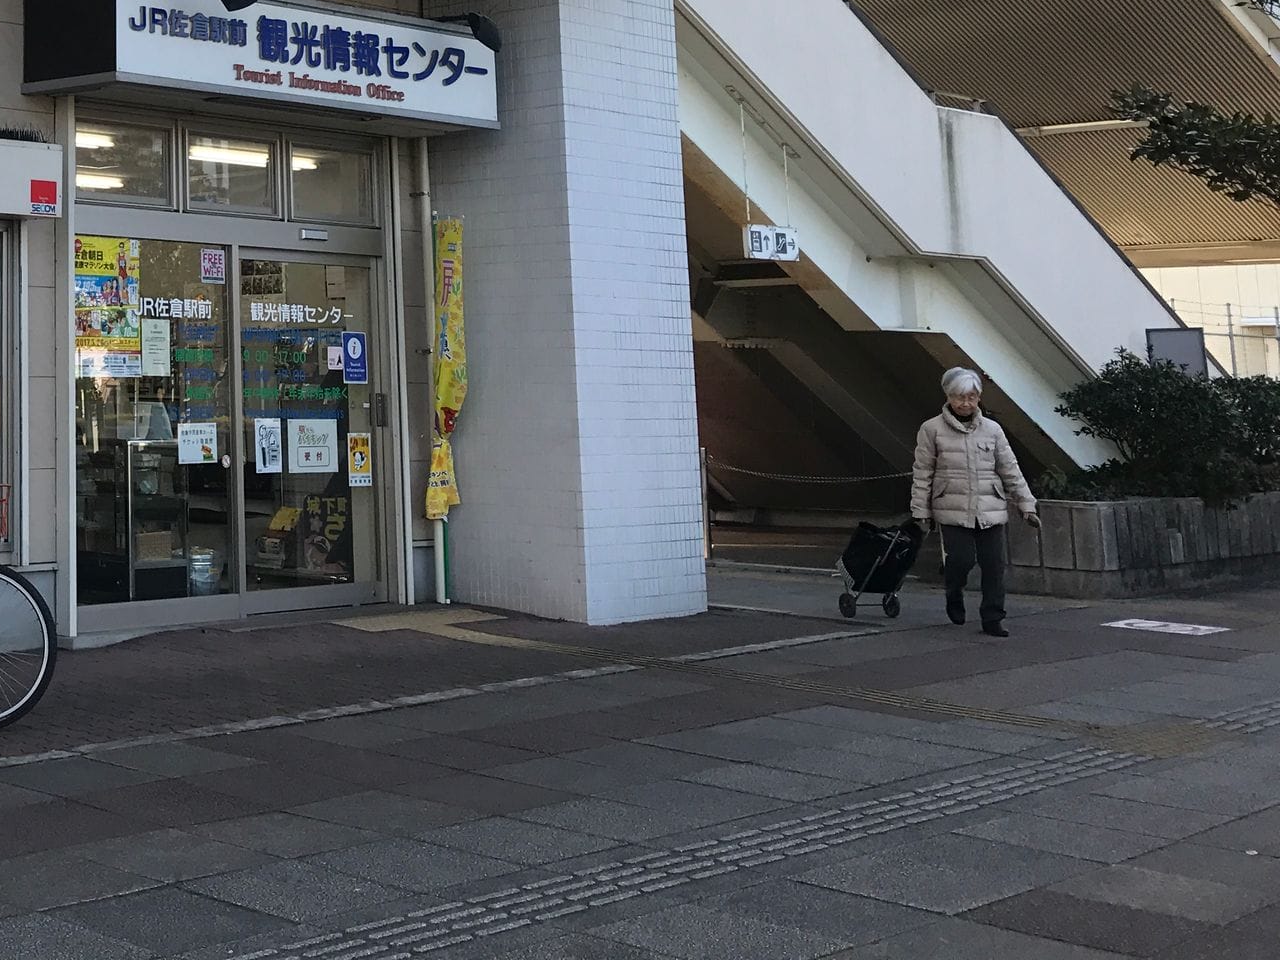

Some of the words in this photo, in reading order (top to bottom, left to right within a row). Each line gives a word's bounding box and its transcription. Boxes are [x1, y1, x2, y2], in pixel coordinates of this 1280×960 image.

[128, 5, 248, 47] JR佐倉駅前
[256, 14, 488, 86] 観光情報センター
[233, 63, 283, 85] Tourist
[288, 71, 362, 96] Information
[366, 82, 406, 102] Office
[31, 203, 56, 214] SECOM
[202, 252, 223, 265] FREE
[203, 265, 224, 277] Wi-Fi
[135, 297, 212, 319] JR佐倉駅前
[250, 302, 354, 325] 観光情報センター
